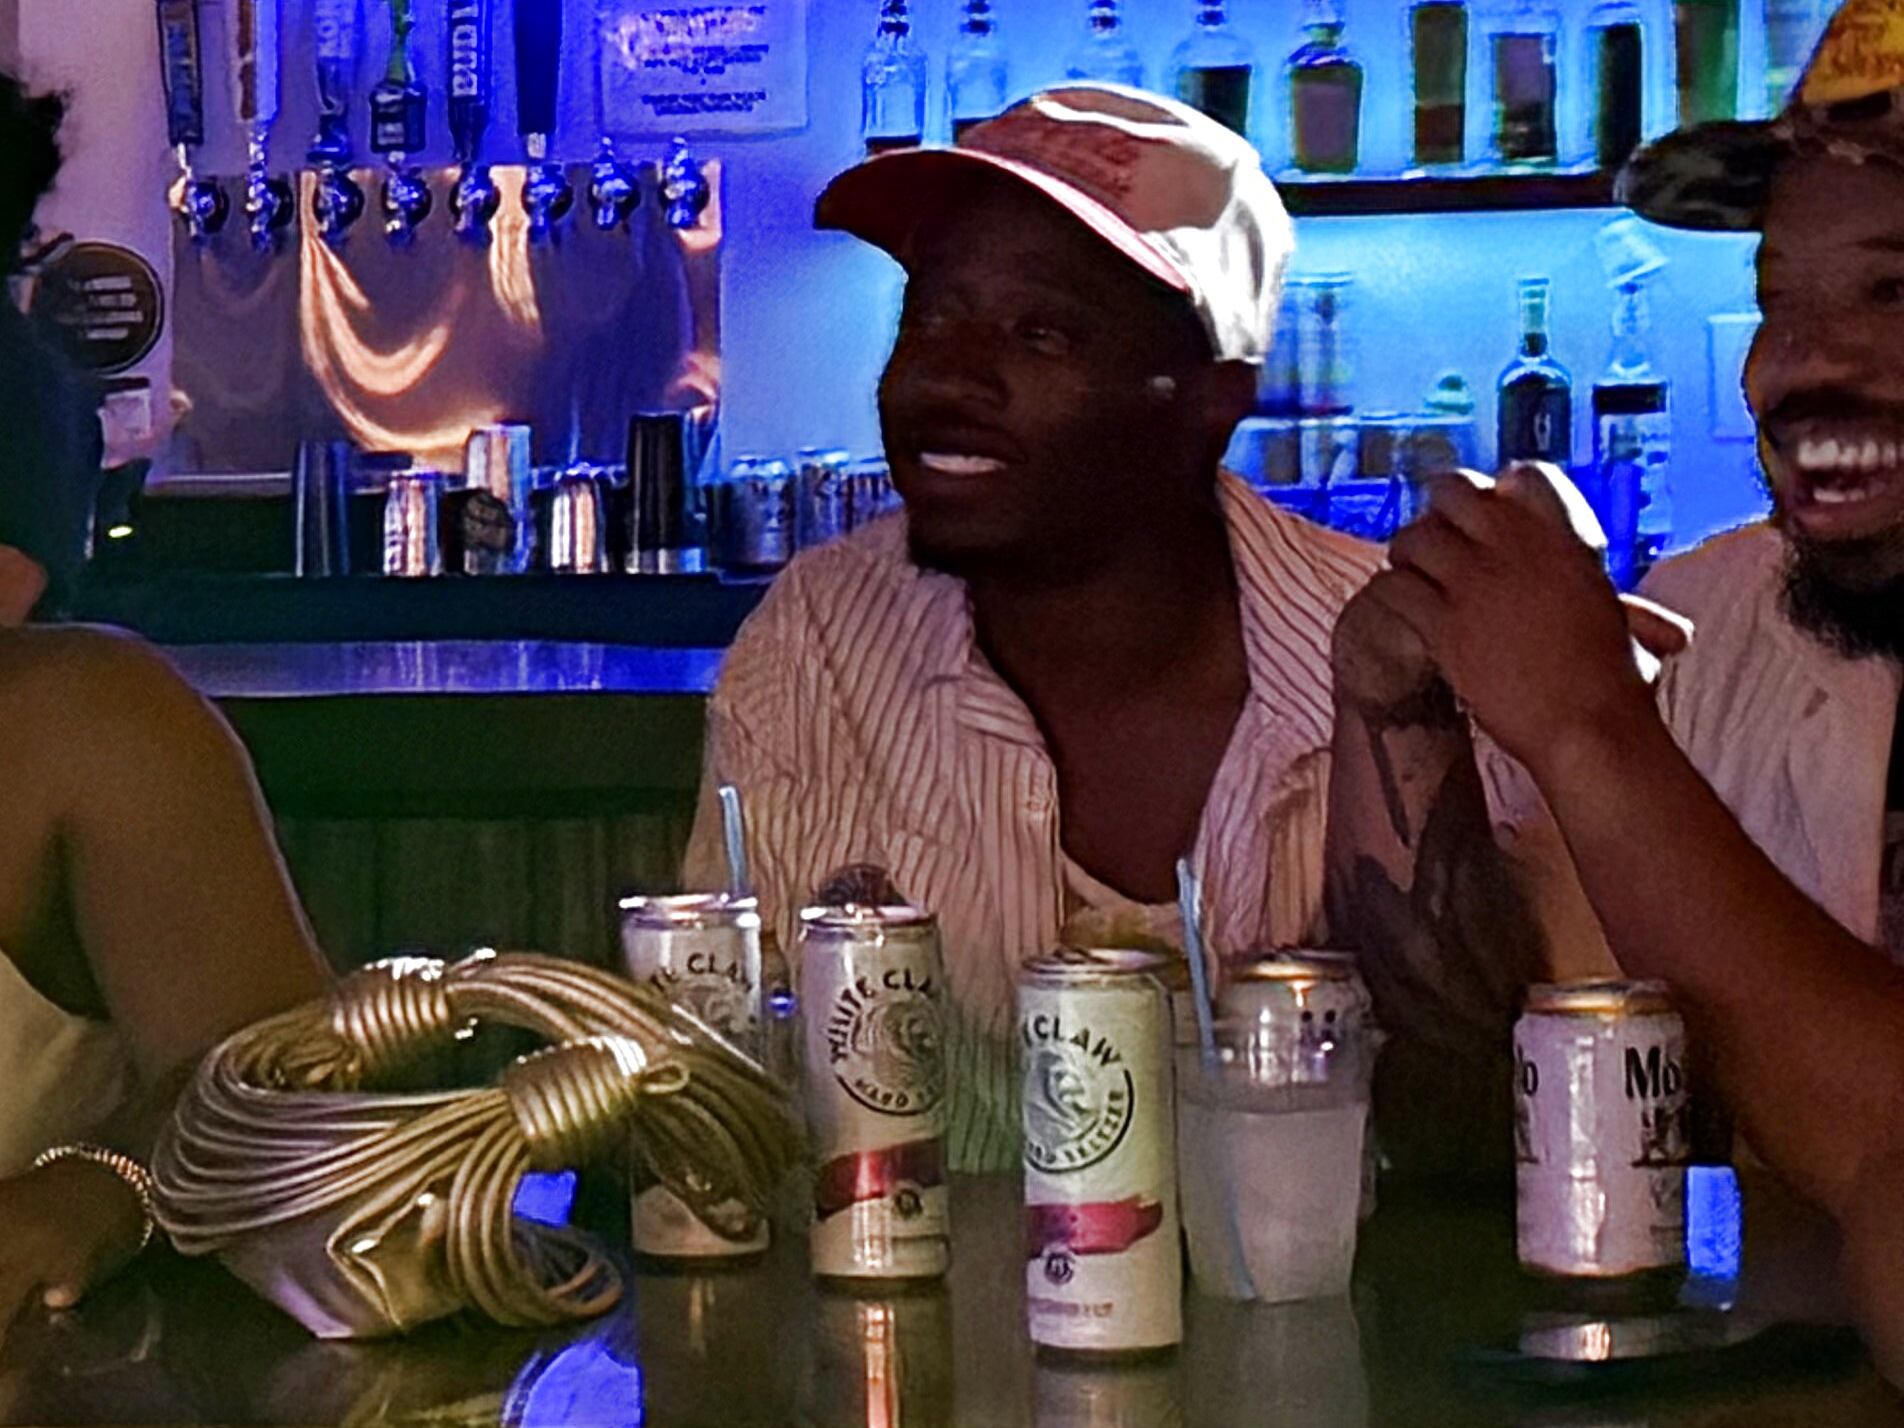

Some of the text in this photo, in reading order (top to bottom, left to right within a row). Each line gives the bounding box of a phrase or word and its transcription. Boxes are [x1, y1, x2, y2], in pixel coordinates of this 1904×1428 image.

[451, 24, 478, 98] BUD
[882, 967, 942, 1000] CLA
[1033, 1014, 1123, 1067] CLAW
